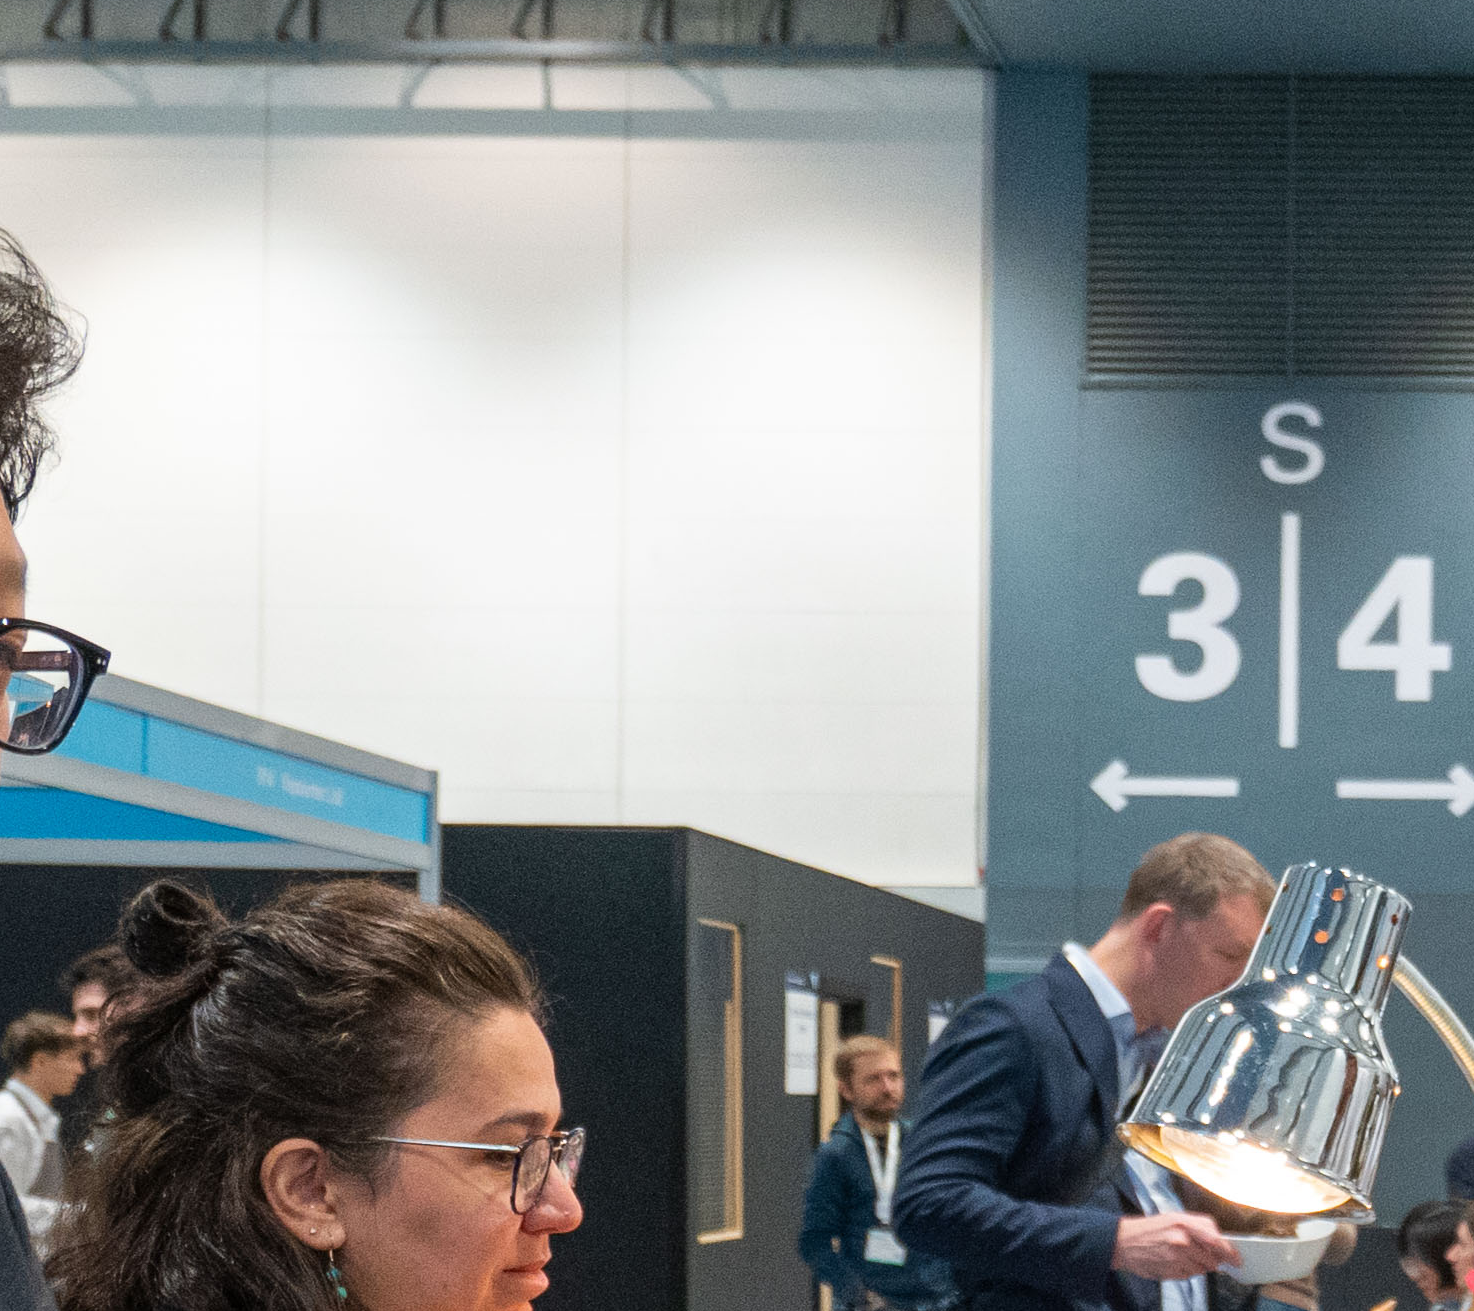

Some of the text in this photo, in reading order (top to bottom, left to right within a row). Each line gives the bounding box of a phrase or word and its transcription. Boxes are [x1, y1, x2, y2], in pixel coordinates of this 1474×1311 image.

[1259, 401, 1325, 485] S
[1134, 551, 1452, 702] 3 4
